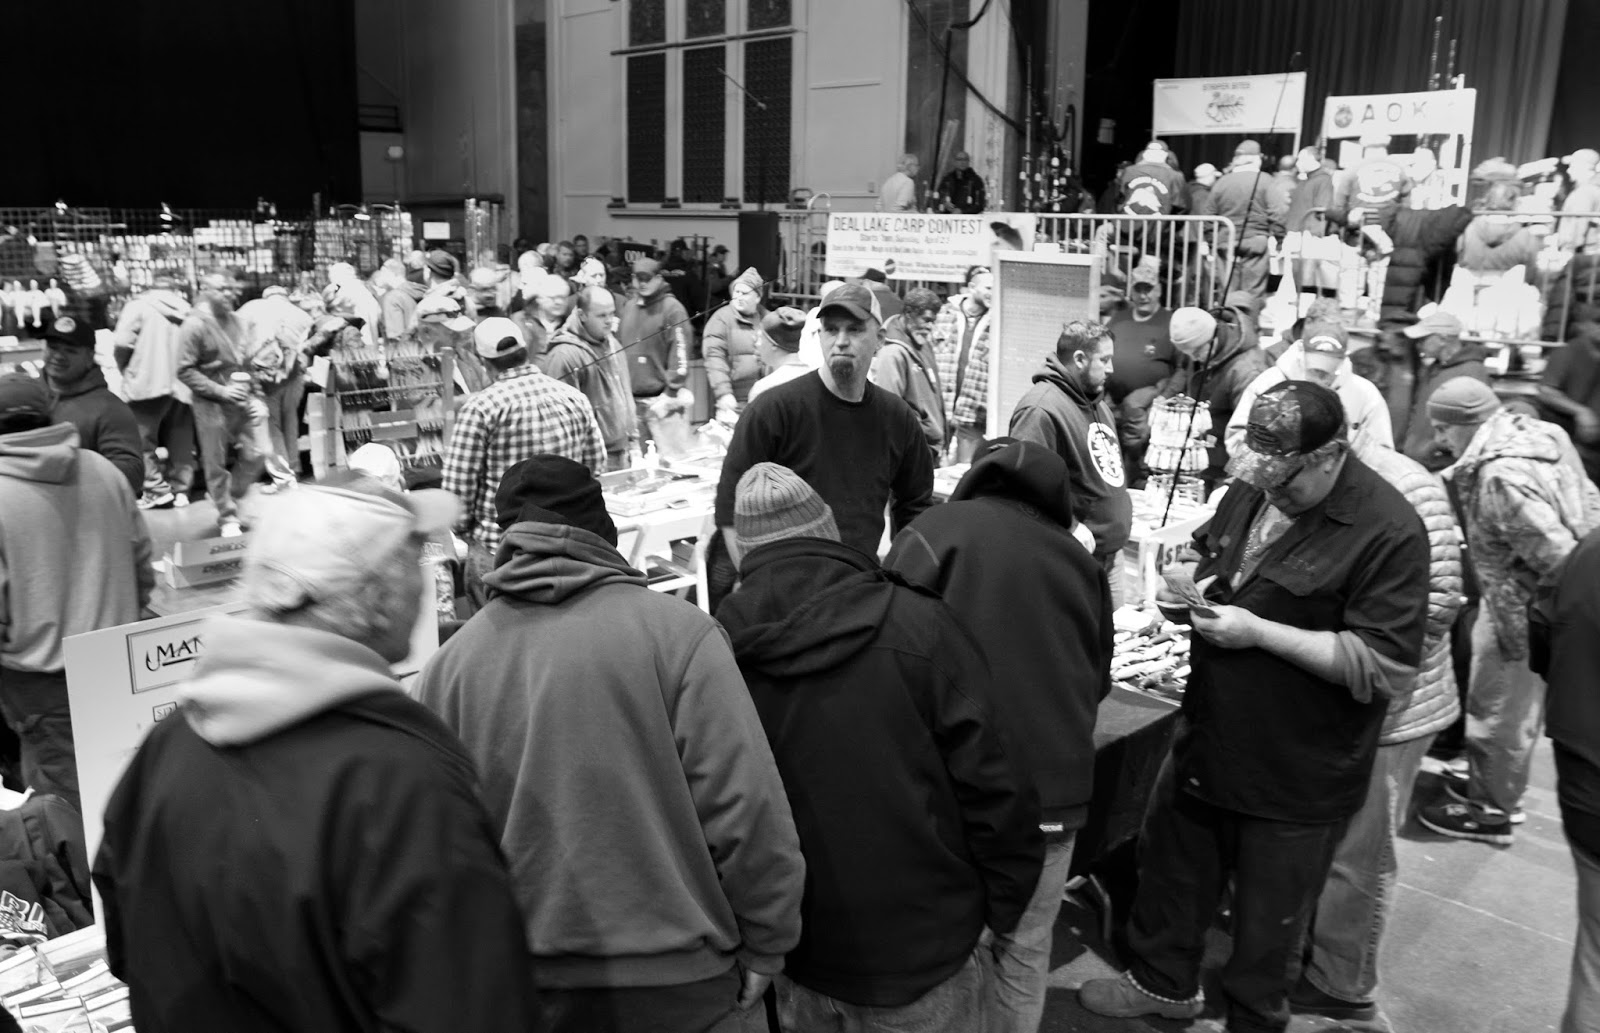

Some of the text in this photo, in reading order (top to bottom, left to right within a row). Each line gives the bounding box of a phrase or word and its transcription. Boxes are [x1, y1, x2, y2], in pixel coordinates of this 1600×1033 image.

[833, 216, 983, 235] DEAL LAKE CARP CONTEST
